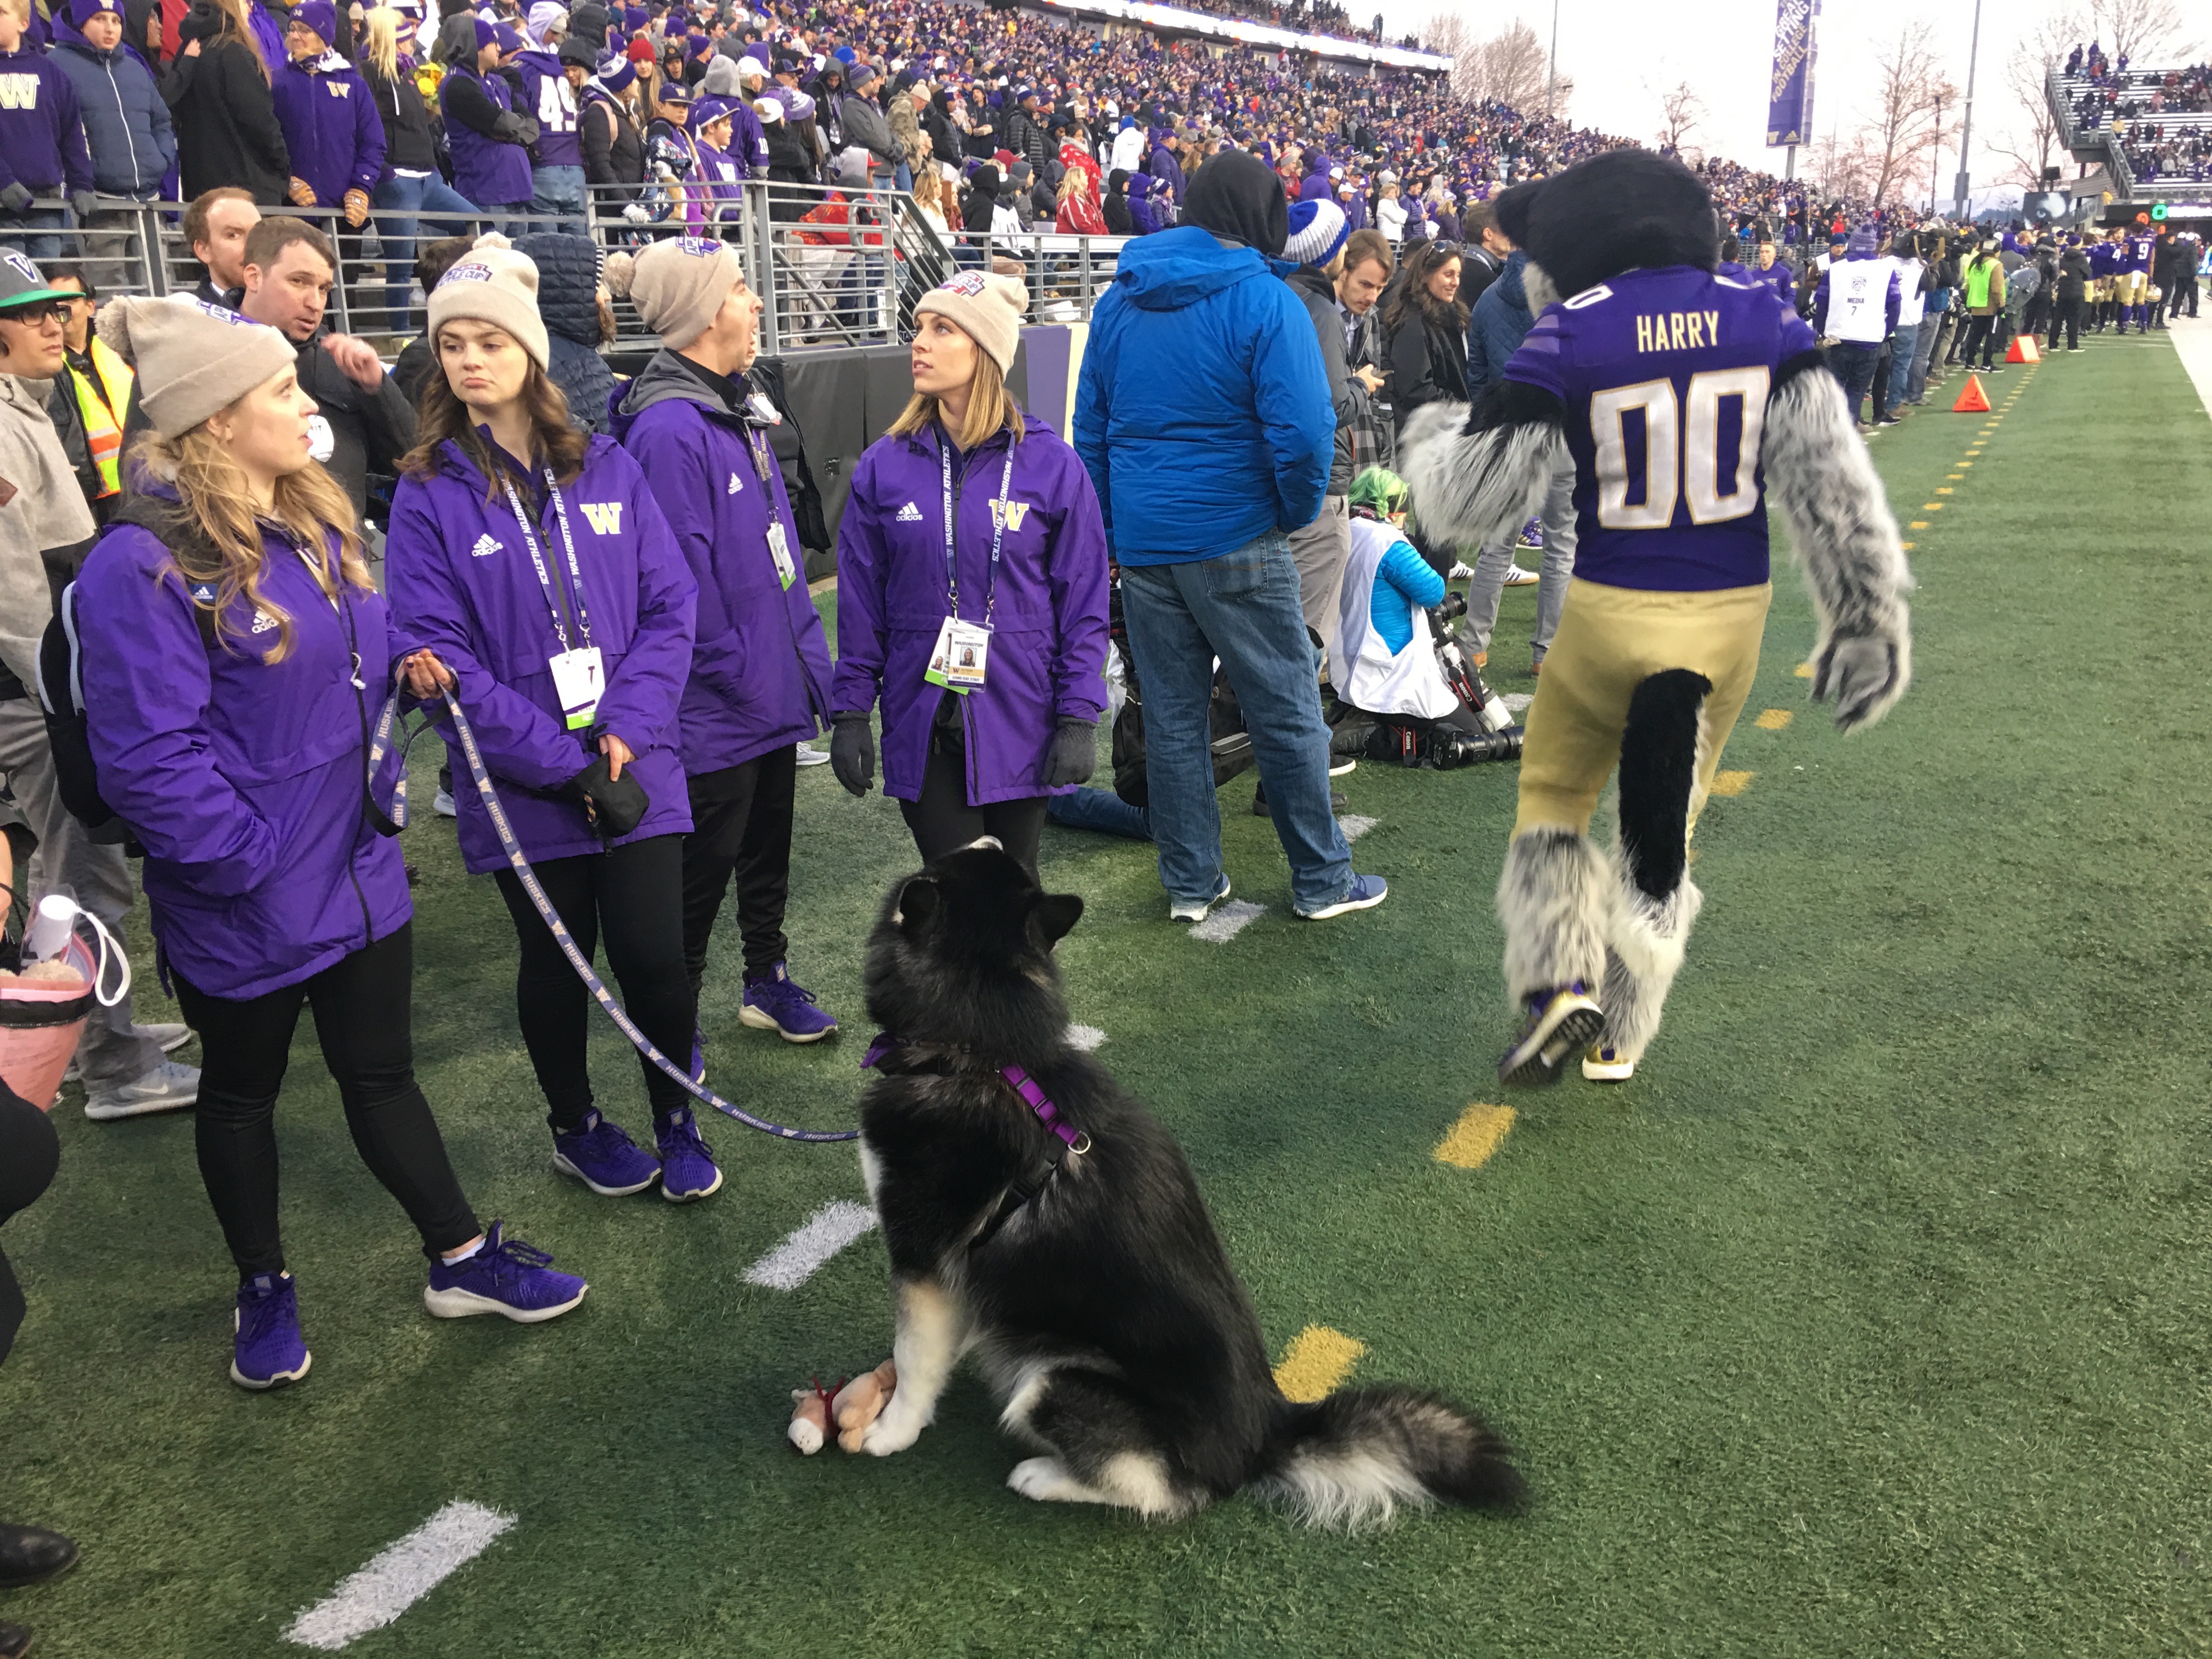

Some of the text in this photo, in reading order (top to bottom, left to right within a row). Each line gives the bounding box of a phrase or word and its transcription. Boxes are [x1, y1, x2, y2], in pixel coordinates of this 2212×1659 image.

[1779, 22, 1808, 70] COLLEGE
[0, 72, 40, 110] W
[326, 81, 351, 99] W
[1772, 46, 1808, 103] FOOTBALL
[2137, 242, 2149, 260] 9
[1636, 309, 1719, 353] HARRY
[1851, 306, 1858, 317] 7
[942, 444, 952, 490] ATHLETICS
[1590, 365, 1771, 529] 00
[544, 468, 567, 515] ATHLETICS
[998, 460, 1012, 514] WASHINGTON
[579, 502, 623, 535] W
[895, 512, 923, 522] adidas
[943, 491, 953, 545] WASHINGTON
[988, 499, 1030, 532] W
[471, 542, 504, 557] adidas
[525, 536, 550, 585] ATHLETICS
[559, 516, 580, 576] WASHINGTON
[992, 515, 1005, 562] ATHLETICS
[251, 614, 290, 634] adids
[1458, 682, 1472, 702] Canon
[459, 725, 481, 769] HUSKIES
[478, 777, 493, 793] W
[488, 802, 513, 844] HUSKIES
[511, 850, 526, 866] W
[523, 874, 552, 914] HUSKIES
[551, 919, 566, 936] W
[565, 942, 594, 981] HUSKIES
[596, 986, 611, 1002] W
[611, 1007, 643, 1043] HUSKIES
[648, 1047, 664, 1061] W
[665, 1065, 704, 1094] HUSKIES
[711, 1096, 727, 1108] W
[731, 1109, 773, 1131] HUSKIES
[782, 1128, 799, 1137] W
